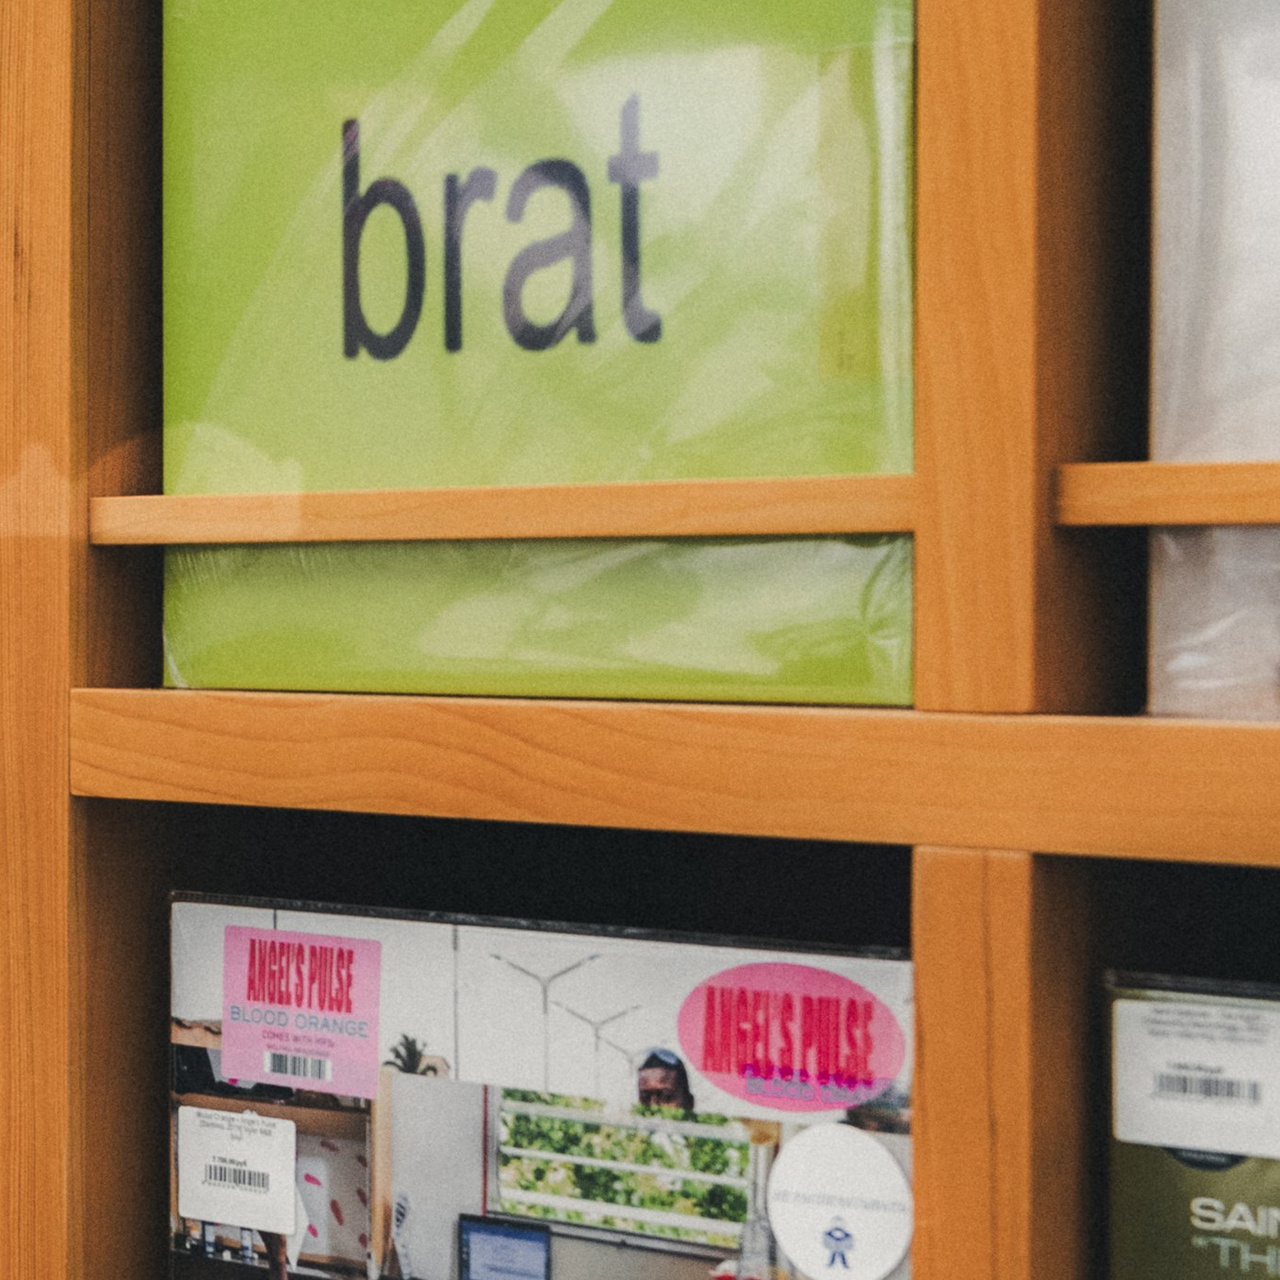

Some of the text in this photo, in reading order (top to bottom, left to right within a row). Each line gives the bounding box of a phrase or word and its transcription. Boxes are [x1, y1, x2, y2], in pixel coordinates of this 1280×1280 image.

[342, 91, 662, 361] brat
[308, 945, 354, 1013] PULSE
[230, 1005, 370, 1038] BLOOD ORANGE
